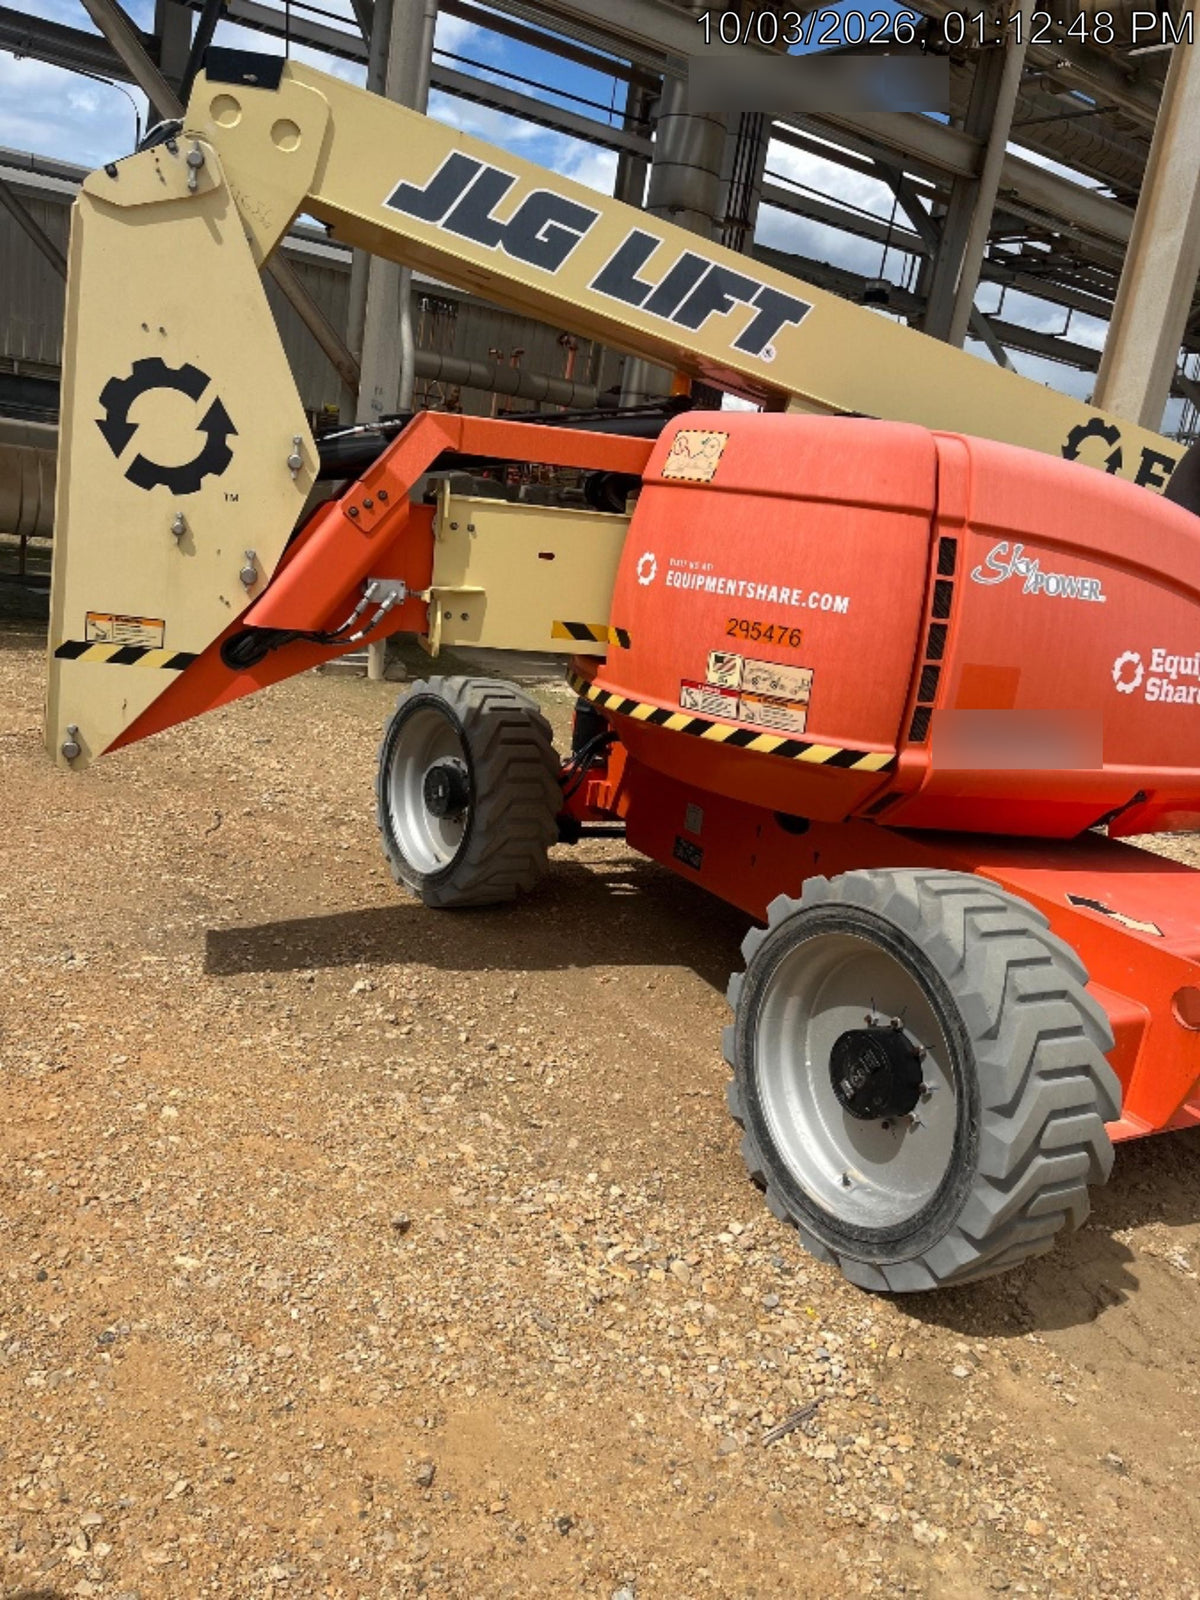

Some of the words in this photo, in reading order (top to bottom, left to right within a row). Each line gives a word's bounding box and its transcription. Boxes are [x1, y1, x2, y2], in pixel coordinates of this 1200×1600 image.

[382, 148, 602, 275] JLG
[586, 226, 815, 358] LIFT
[666, 570, 850, 614] EQUIPMENTSHARE.COM
[726, 618, 802, 648] 295476
[1149, 648, 1200, 681] Equi
